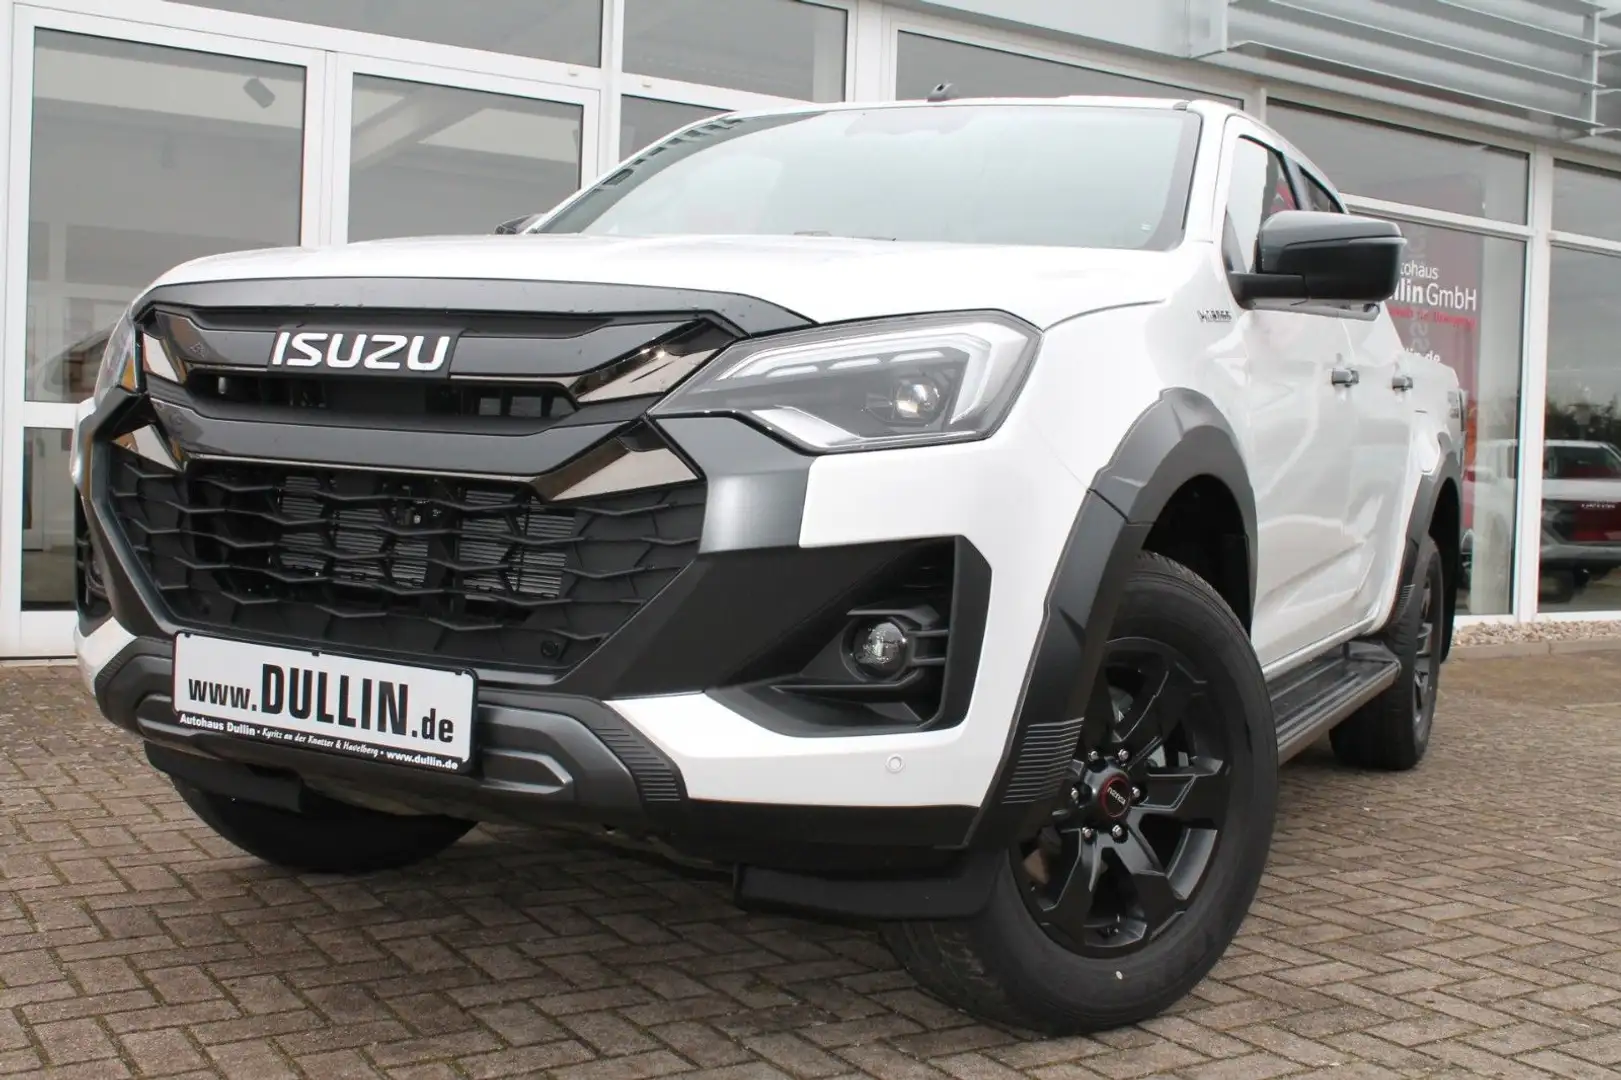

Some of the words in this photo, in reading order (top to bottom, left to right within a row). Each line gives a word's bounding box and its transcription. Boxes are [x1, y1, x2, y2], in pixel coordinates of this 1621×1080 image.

[1400, 260, 1439, 280] ohaus
[1426, 282, 1477, 311] GmbH
[272, 331, 451, 371] ISUZU
[188, 663, 454, 743] www.DULLIN.de
[179, 713, 225, 731] Autohaus
[226, 722, 256, 736] Dullin
[261, 727, 282, 740] Kyritz
[283, 732, 293, 741] an
[294, 732, 306, 743] der
[308, 734, 334, 748] Knatter
[335, 739, 341, 749] &
[343, 740, 379, 757] Havelberg
[386, 751, 459, 770] www.dullin.de
